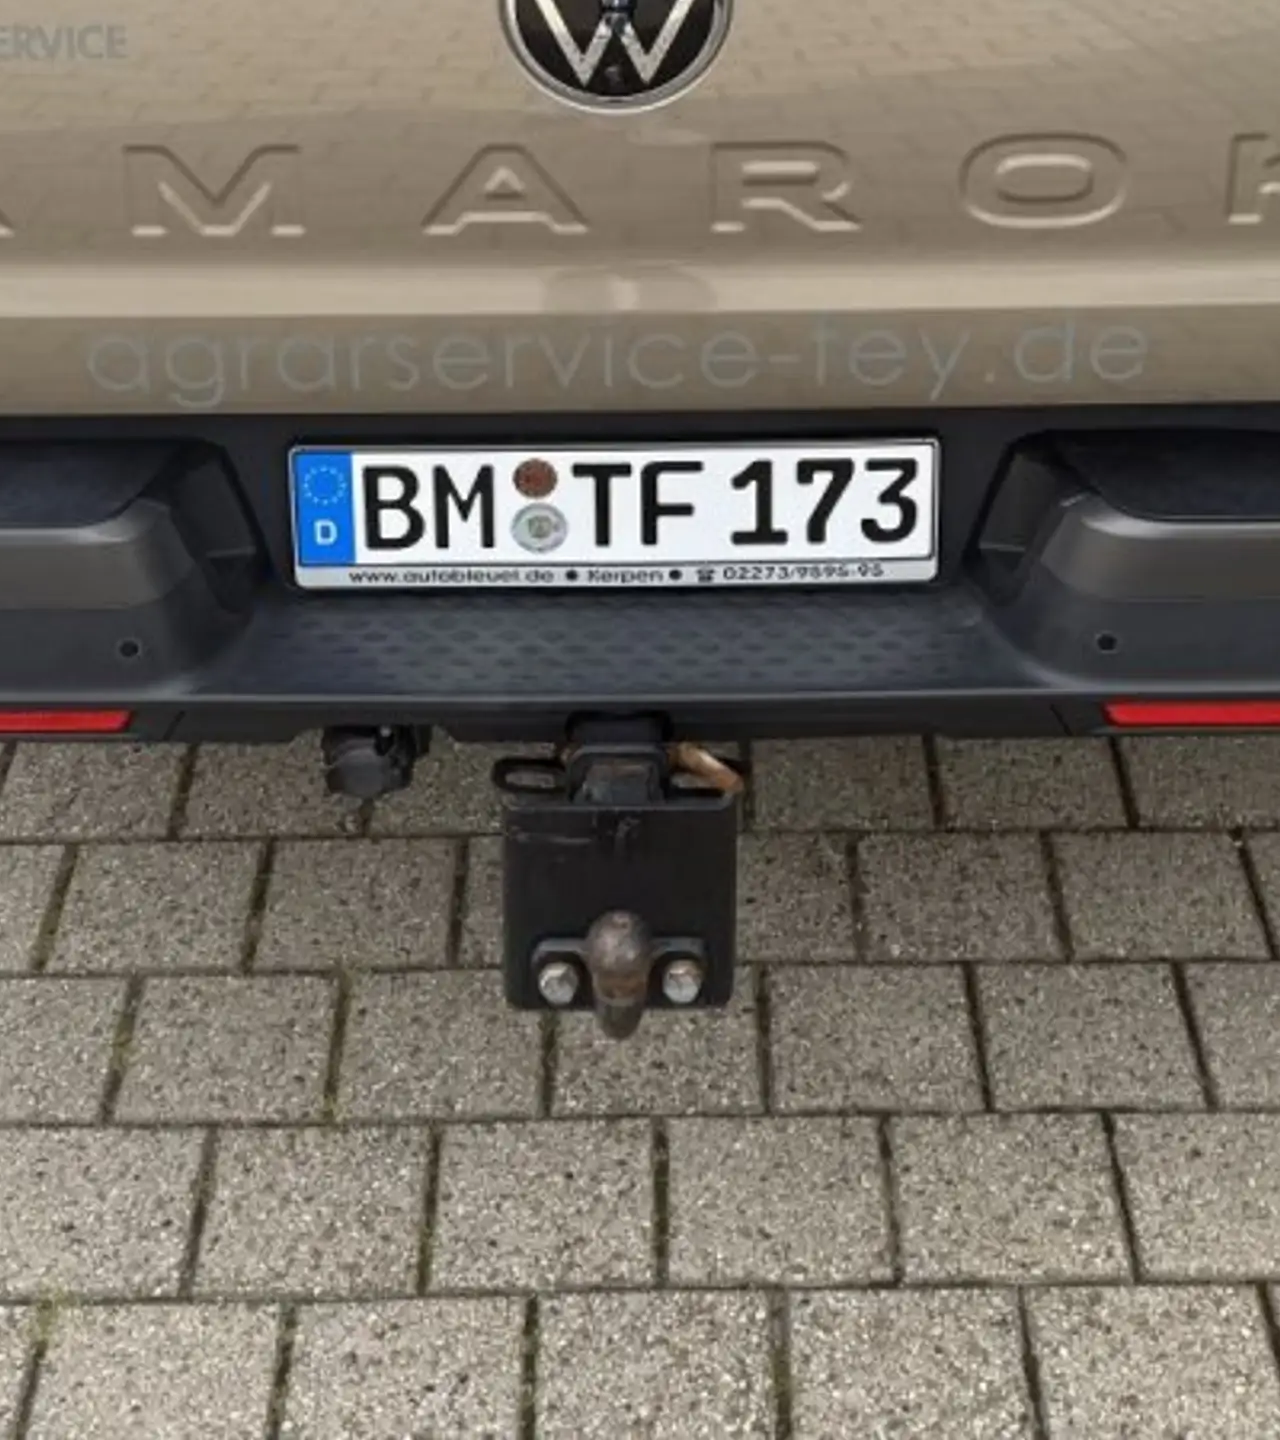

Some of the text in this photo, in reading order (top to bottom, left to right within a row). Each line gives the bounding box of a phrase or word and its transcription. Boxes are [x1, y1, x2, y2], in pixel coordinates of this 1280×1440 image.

[313, 458, 918, 550] D BM TF 173
[588, 568, 663, 584] Kerpen
